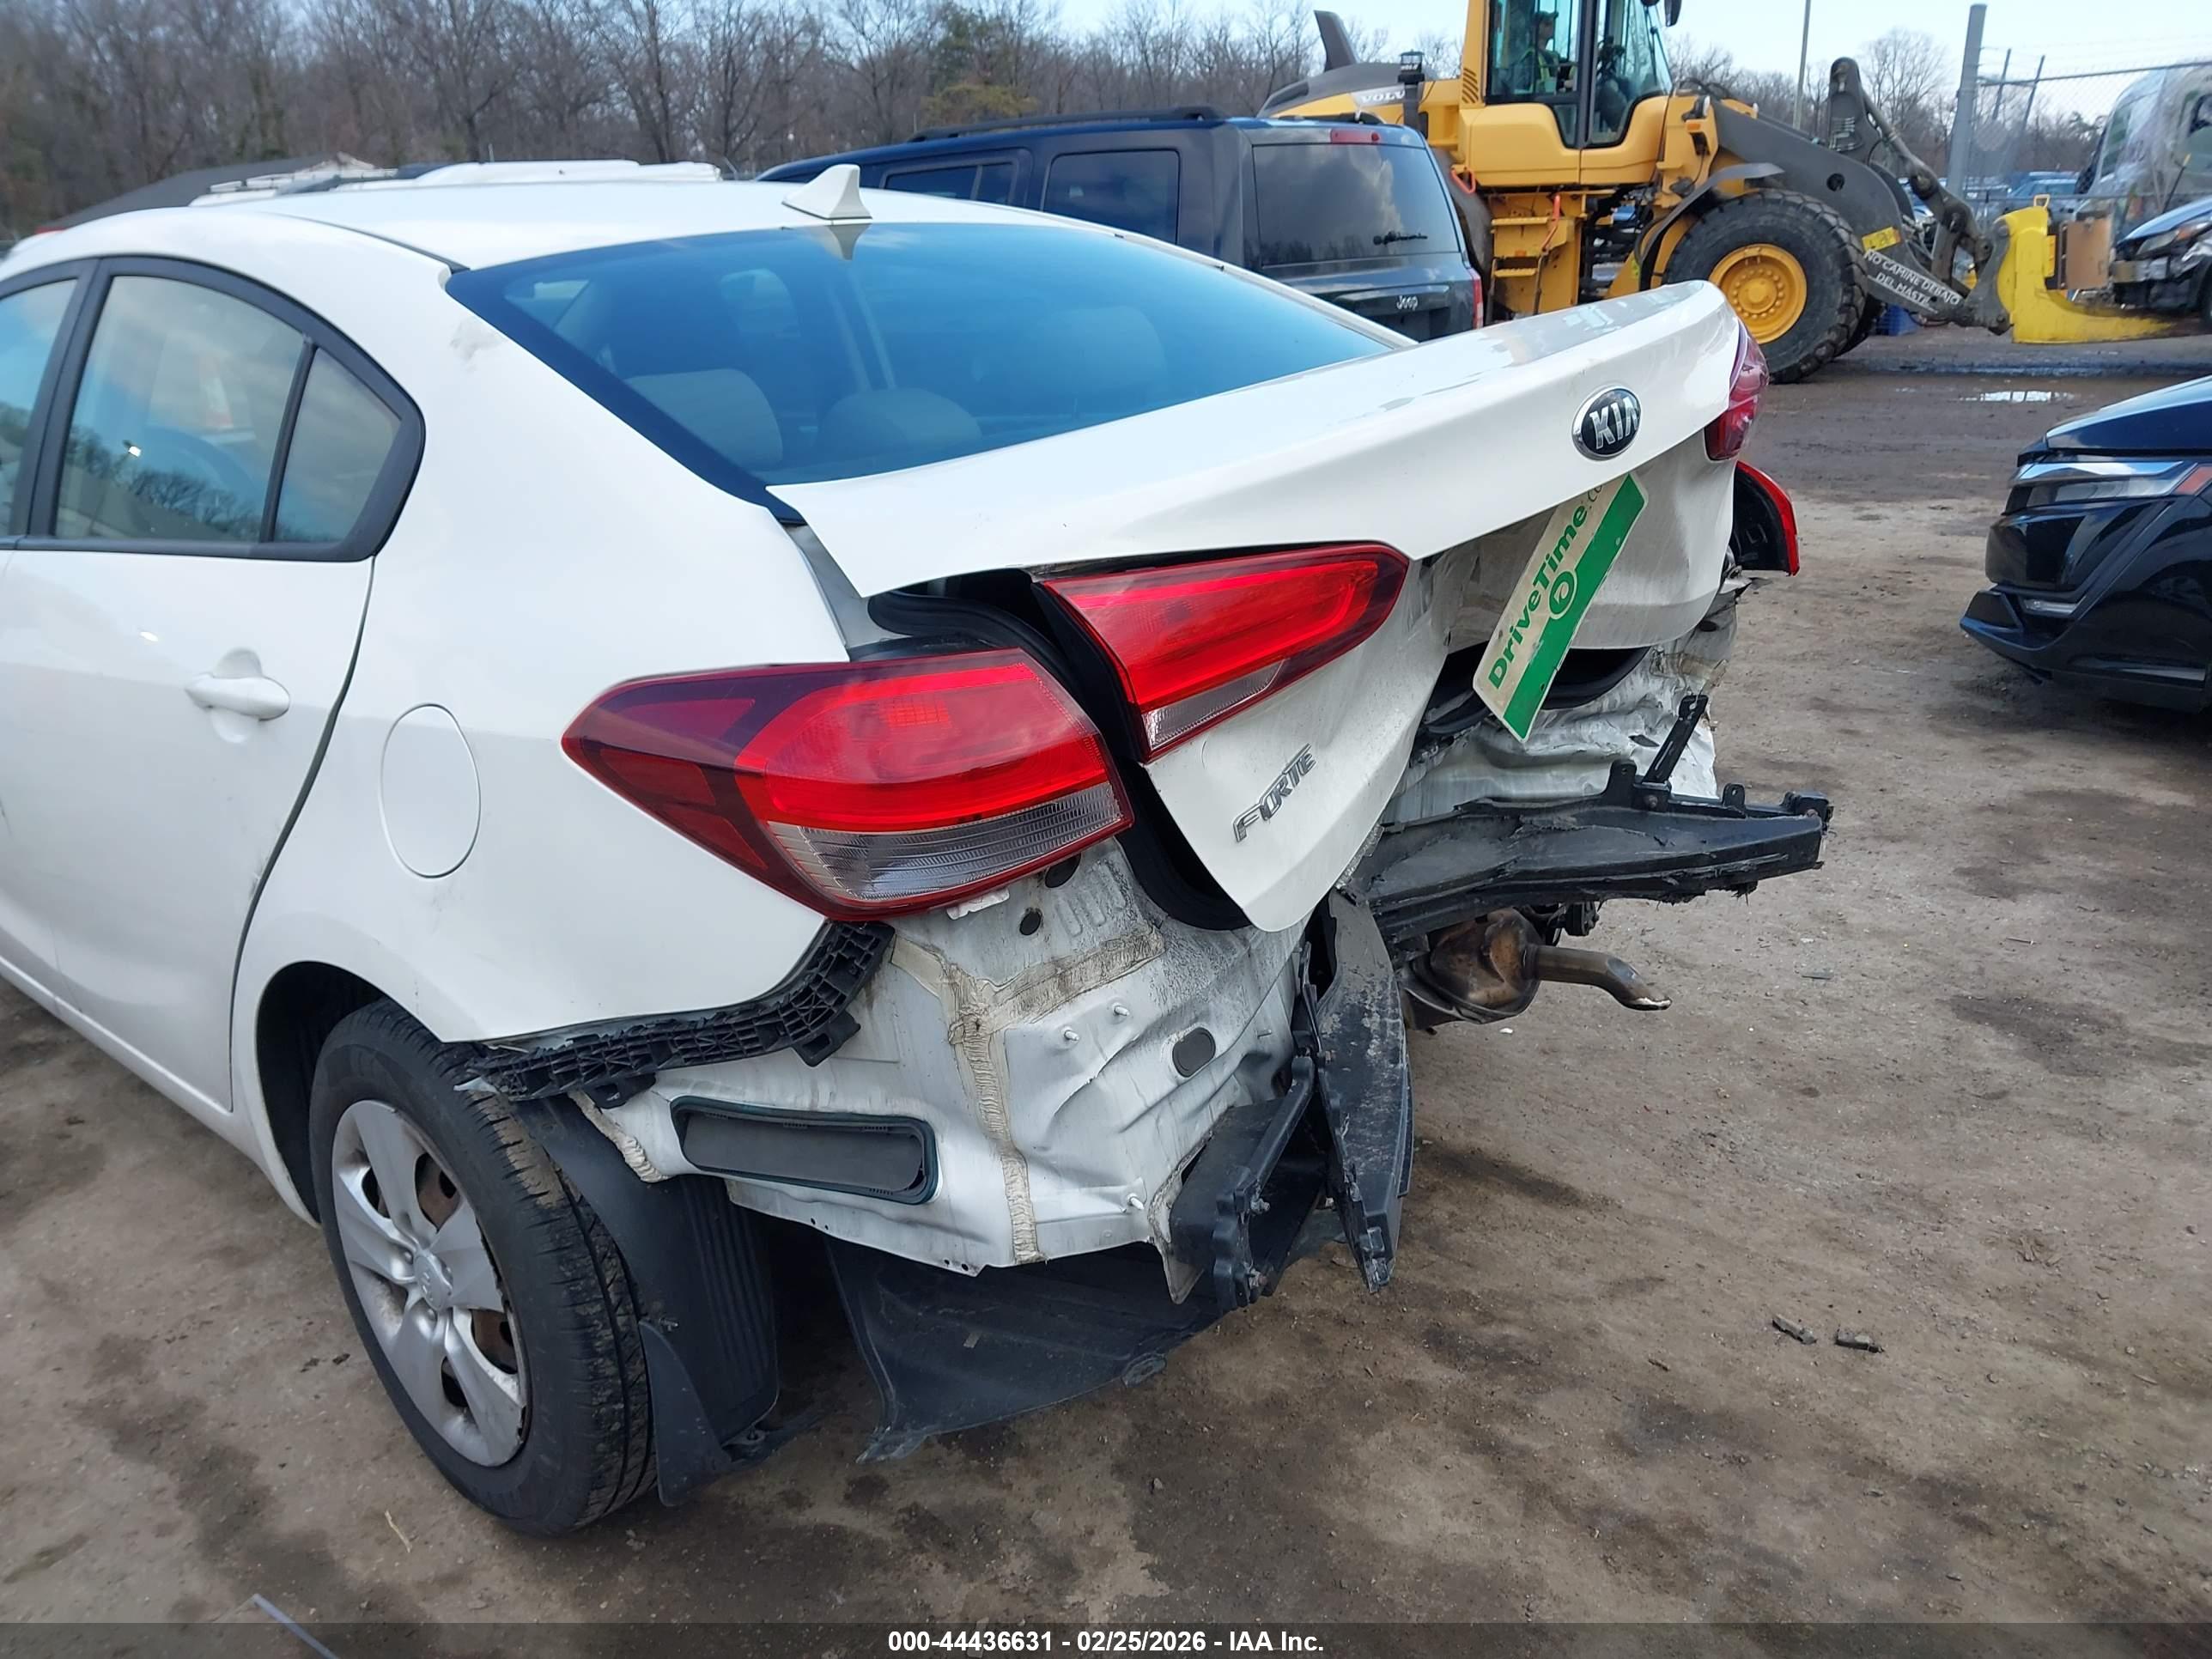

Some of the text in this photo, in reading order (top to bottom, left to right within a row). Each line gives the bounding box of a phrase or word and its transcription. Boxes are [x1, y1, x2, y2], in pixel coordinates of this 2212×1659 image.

[1361, 89, 1406, 101] VOLV
[1864, 248, 1882, 264] NO
[1875, 271, 1894, 288] DEL
[1396, 295, 1419, 311] Jeep
[1589, 396, 1640, 450] KIA
[1232, 743, 1316, 842] FORTE
